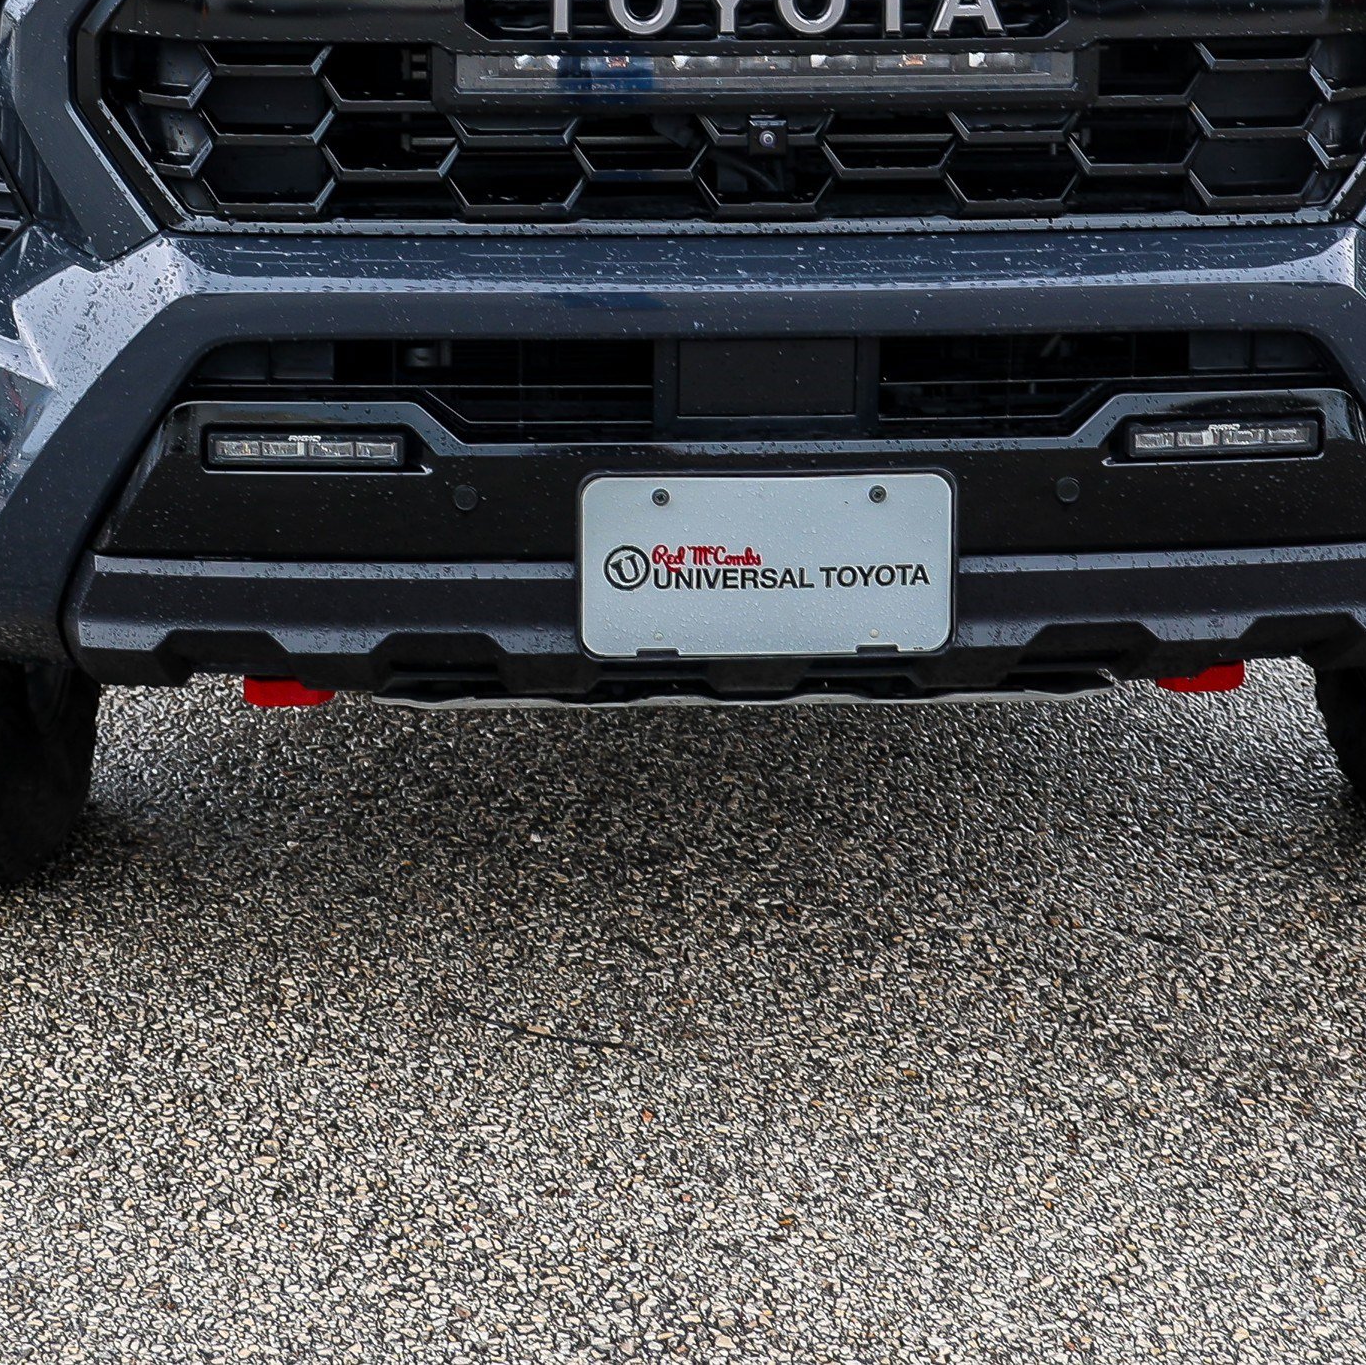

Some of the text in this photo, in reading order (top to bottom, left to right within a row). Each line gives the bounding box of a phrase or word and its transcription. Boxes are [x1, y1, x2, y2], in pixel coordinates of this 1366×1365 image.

[651, 544, 762, 573] Red McCombs
[652, 563, 931, 590] UNIVERSAL TOYOTA
